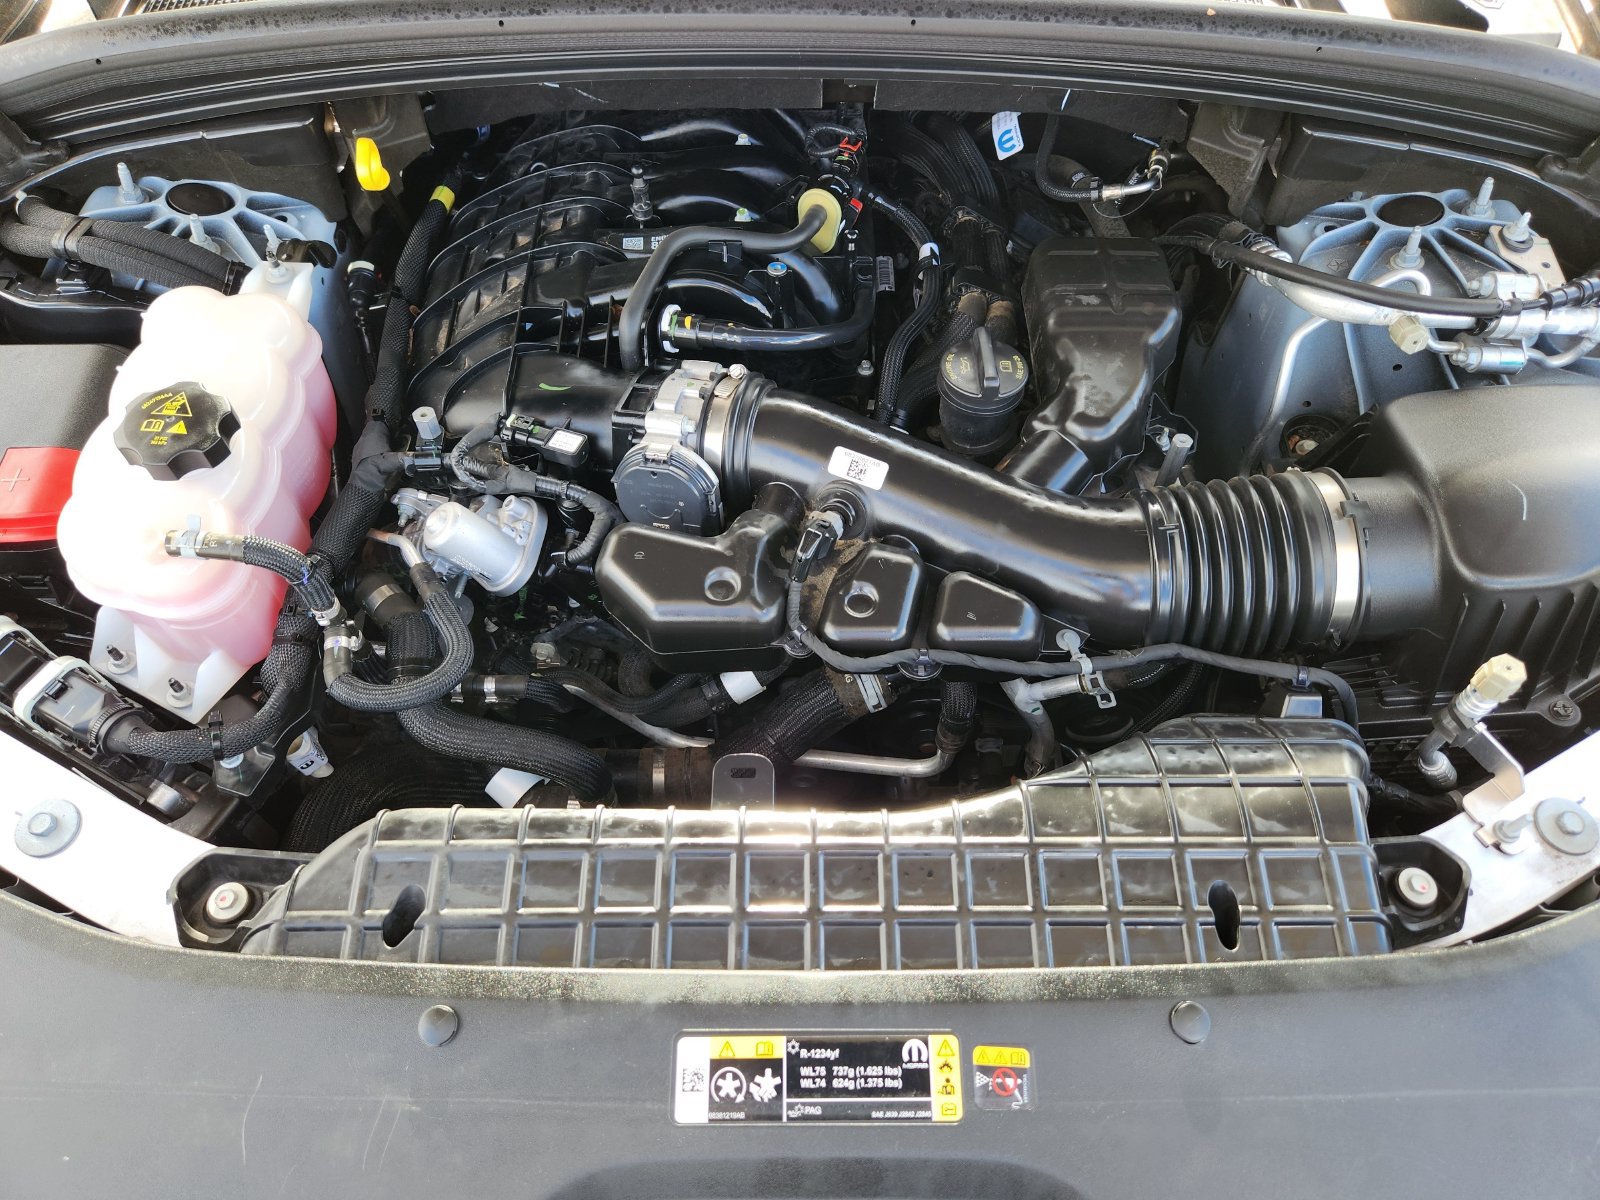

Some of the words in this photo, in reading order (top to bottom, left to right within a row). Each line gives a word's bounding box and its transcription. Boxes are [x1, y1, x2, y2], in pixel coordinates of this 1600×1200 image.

[800, 1048, 840, 1060] R-1234yf
[800, 1066, 826, 1077] WL75
[832, 1066, 855, 1078] 737g
[856, 1066, 884, 1078] (1.625
[884, 1065, 902, 1078] lbs)
[800, 1078, 826, 1089] WL74
[832, 1079, 855, 1090] 624g
[856, 1078, 884, 1090] (1.375
[884, 1078, 902, 1090] lbs)
[804, 1105, 822, 1115] PAG
